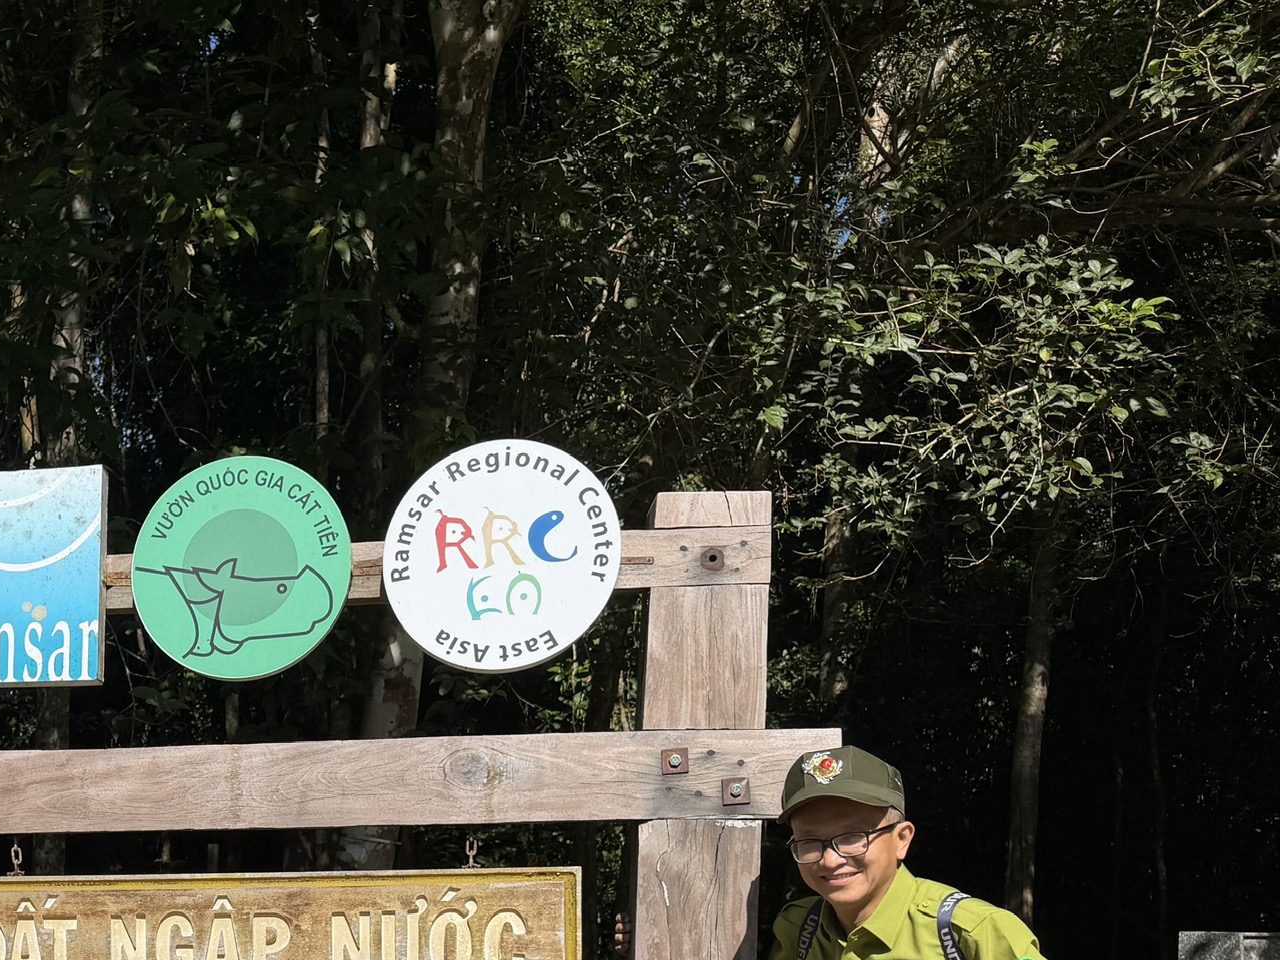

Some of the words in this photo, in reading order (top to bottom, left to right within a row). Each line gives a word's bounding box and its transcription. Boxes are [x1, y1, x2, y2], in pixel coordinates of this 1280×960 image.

[151, 490, 195, 539] VƯỜN
[255, 470, 285, 493] GIA
[287, 483, 322, 515] CÁT
[314, 514, 339, 557] TIÊN
[391, 480, 441, 583] Ramsar
[445, 446, 580, 487] Regional
[578, 486, 613, 583] Center
[435, 629, 490, 663] Asia
[499, 630, 559, 662] East
